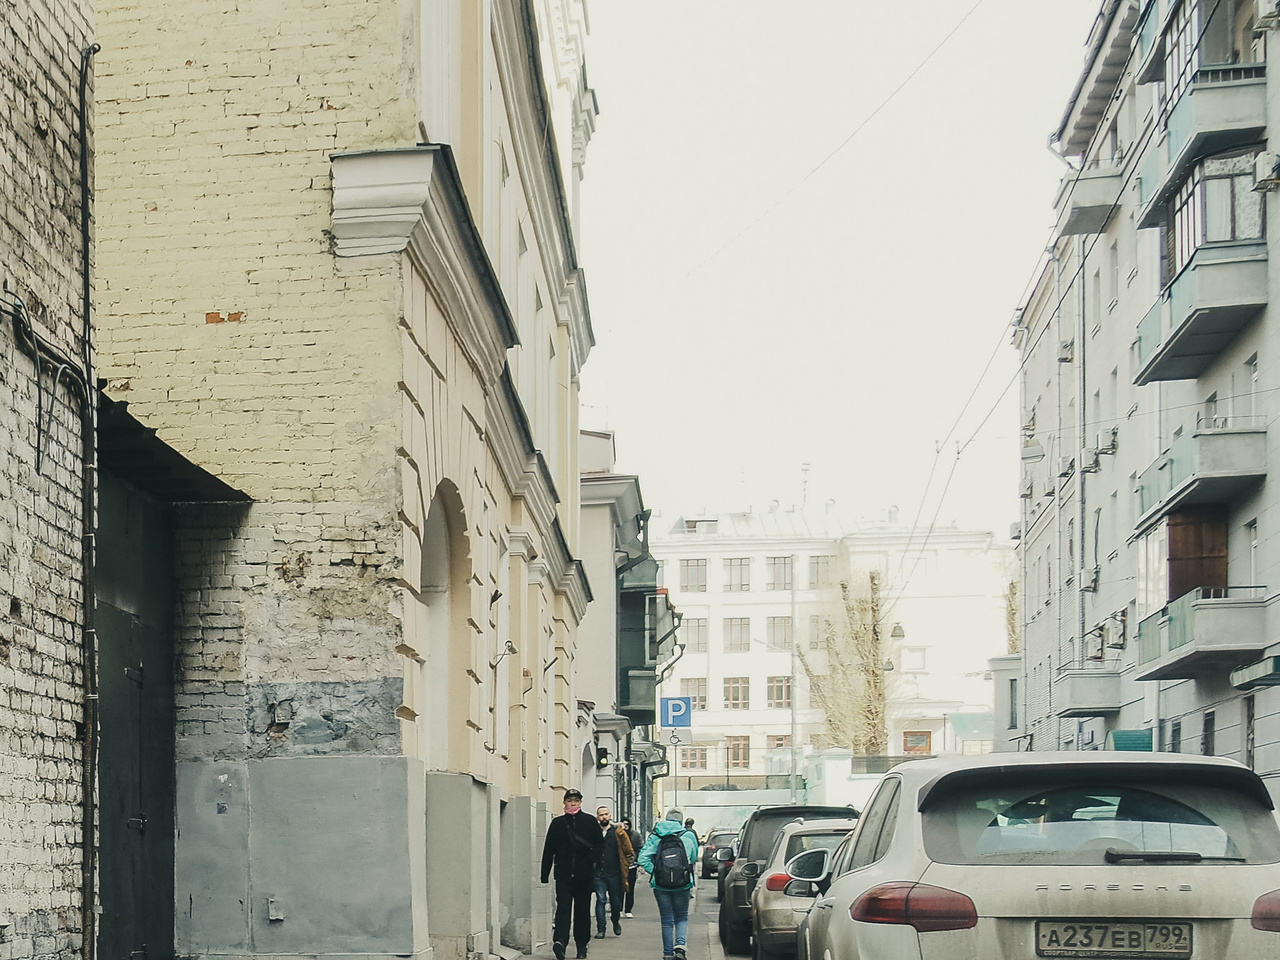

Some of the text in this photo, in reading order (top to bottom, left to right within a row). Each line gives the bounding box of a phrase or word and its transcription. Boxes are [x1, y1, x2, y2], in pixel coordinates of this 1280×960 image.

[668, 700, 686, 724] P
[1035, 883, 1193, 892] PORSCHE
[1146, 925, 1184, 943] 799
[1155, 942, 1173, 950] RUS
